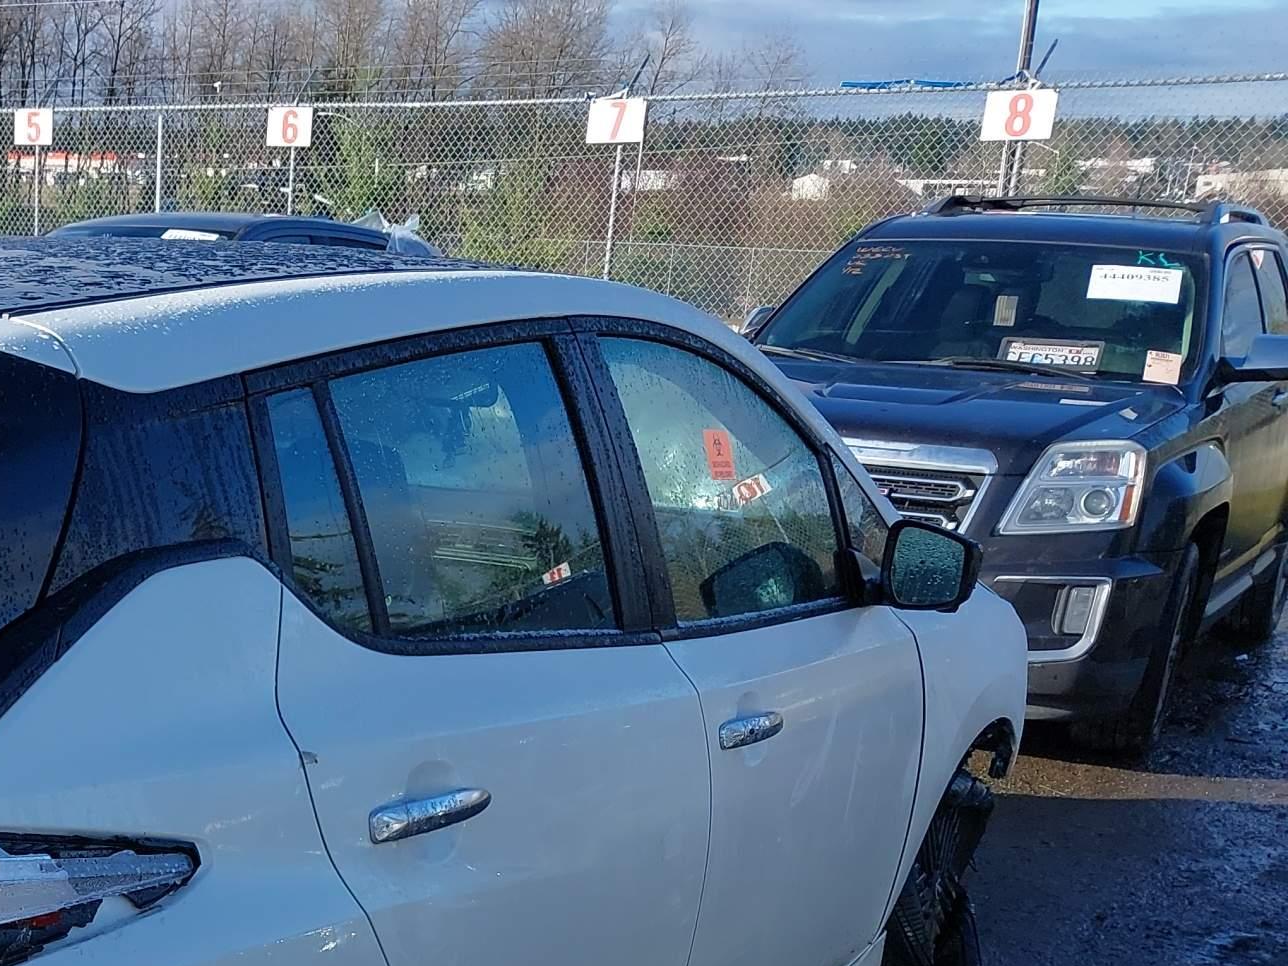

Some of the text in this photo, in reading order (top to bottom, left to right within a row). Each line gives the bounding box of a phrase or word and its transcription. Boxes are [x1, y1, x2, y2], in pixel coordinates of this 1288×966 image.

[26, 111, 41, 142] 5
[281, 110, 299, 144] 6
[610, 101, 627, 140] 7
[1004, 93, 1033, 137] 8
[1010, 344, 1065, 354] WASHINGTON
